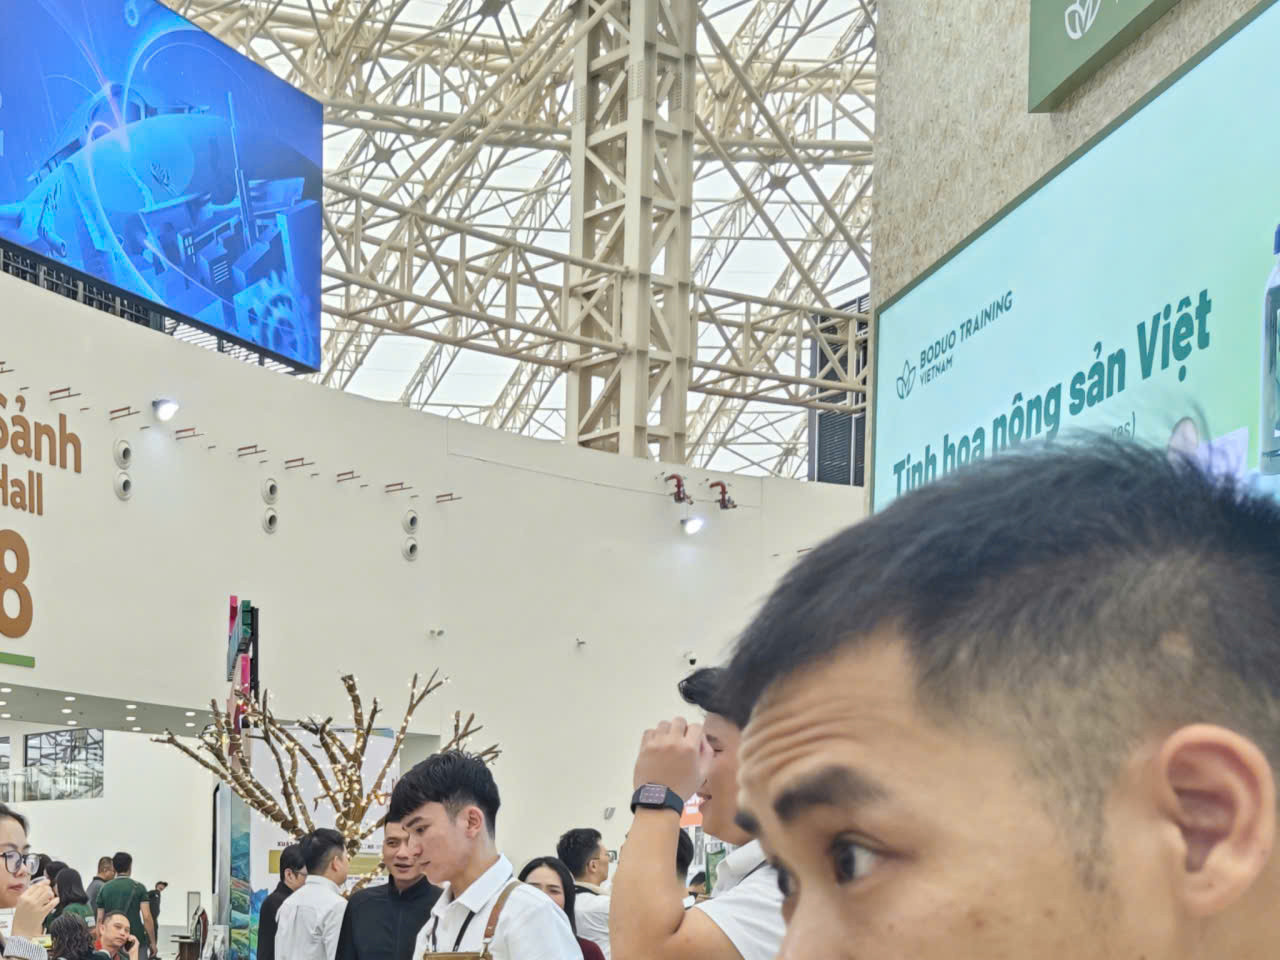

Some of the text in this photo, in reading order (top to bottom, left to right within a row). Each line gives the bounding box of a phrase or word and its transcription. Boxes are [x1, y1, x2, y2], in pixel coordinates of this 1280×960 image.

[920, 290, 1012, 369] BODUO TRAINING
[920, 354, 953, 386] VIETNAM
[943, 426, 985, 474] hoa
[992, 382, 1062, 450] nông
[1069, 341, 1126, 416] sản
[1136, 288, 1212, 383] Việt
